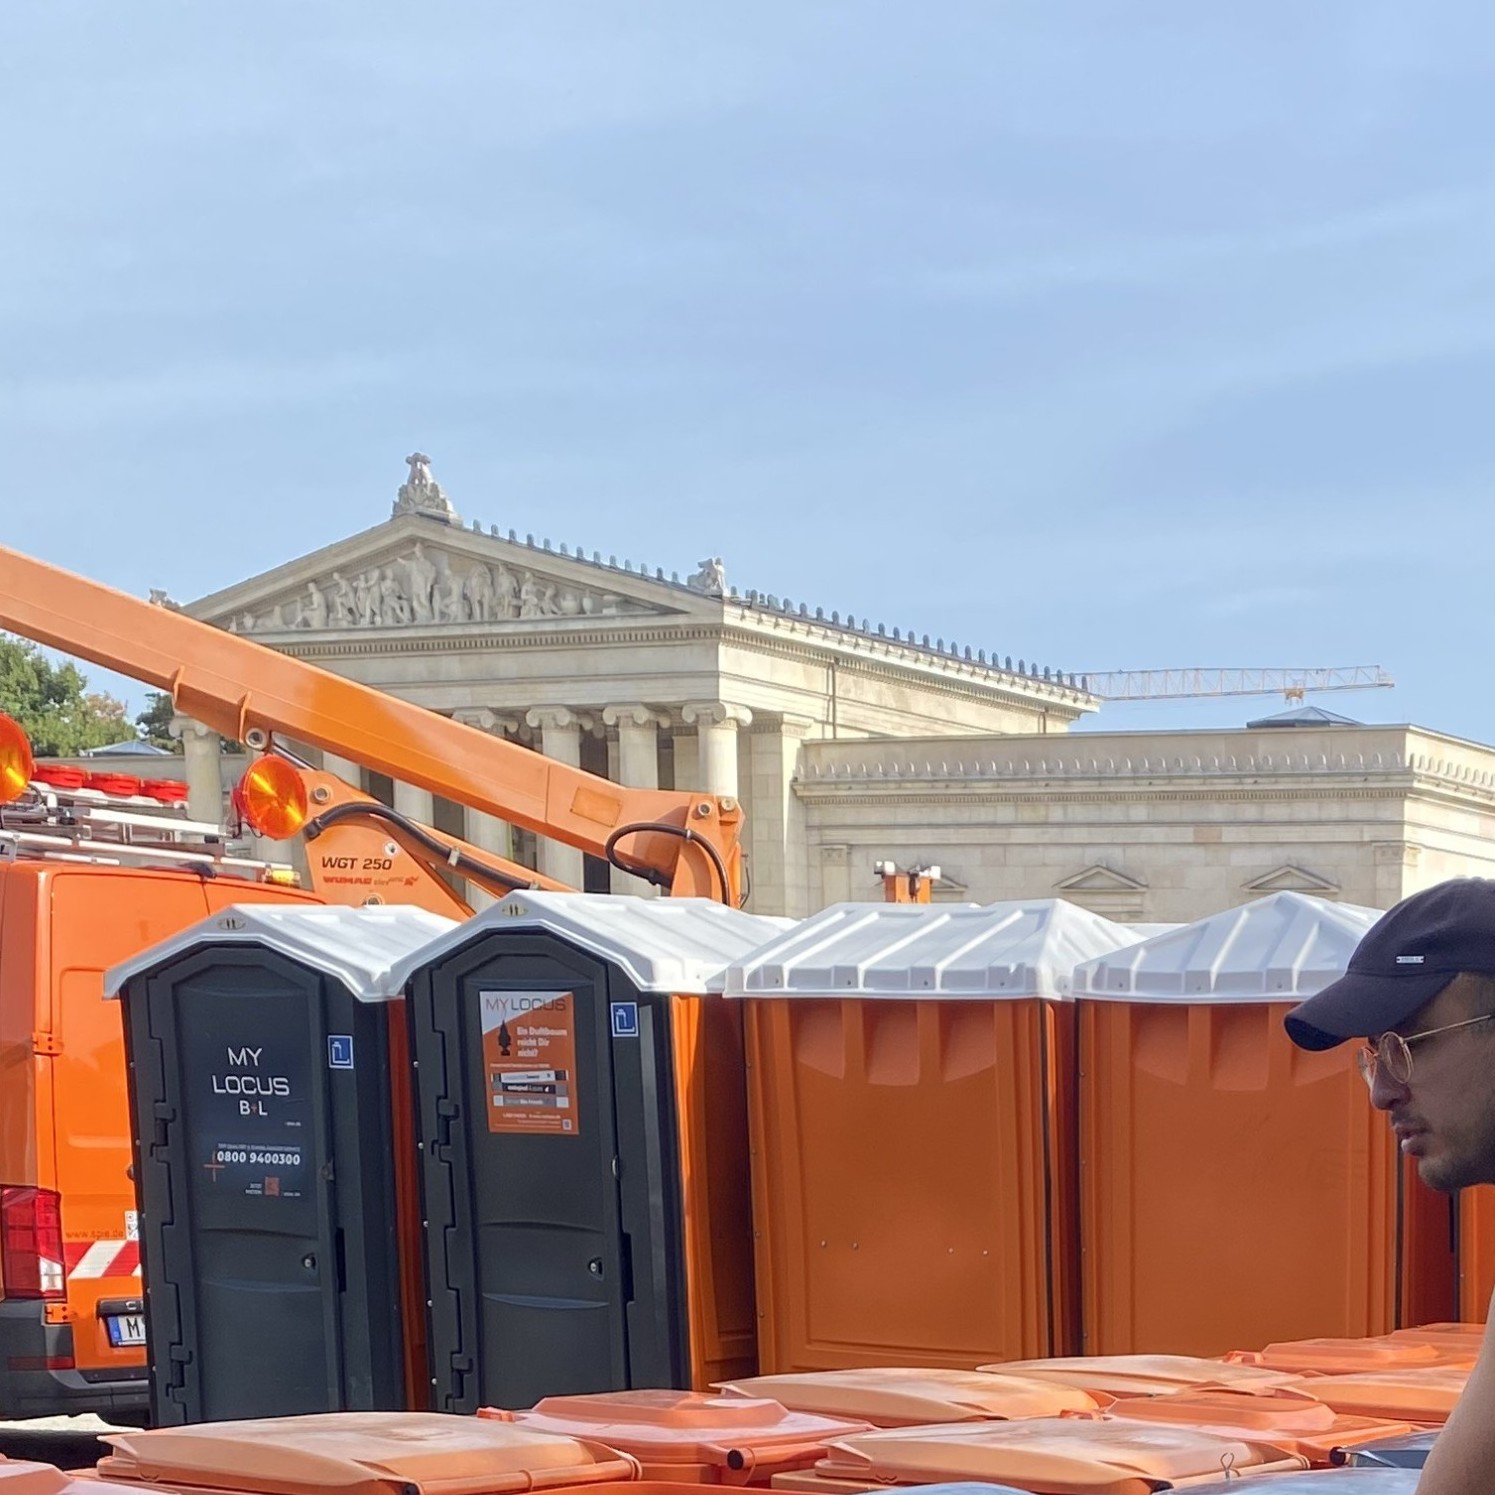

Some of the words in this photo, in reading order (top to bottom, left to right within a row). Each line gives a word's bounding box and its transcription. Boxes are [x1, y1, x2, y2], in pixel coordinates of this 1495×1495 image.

[321, 856, 358, 870] WGT
[362, 858, 393, 871] 250
[511, 998, 566, 1012] LOCUS
[227, 1047, 262, 1067] MY
[212, 1075, 290, 1096] LOCUS
[217, 1150, 247, 1163] 0800
[249, 1152, 301, 1166] 9400300
